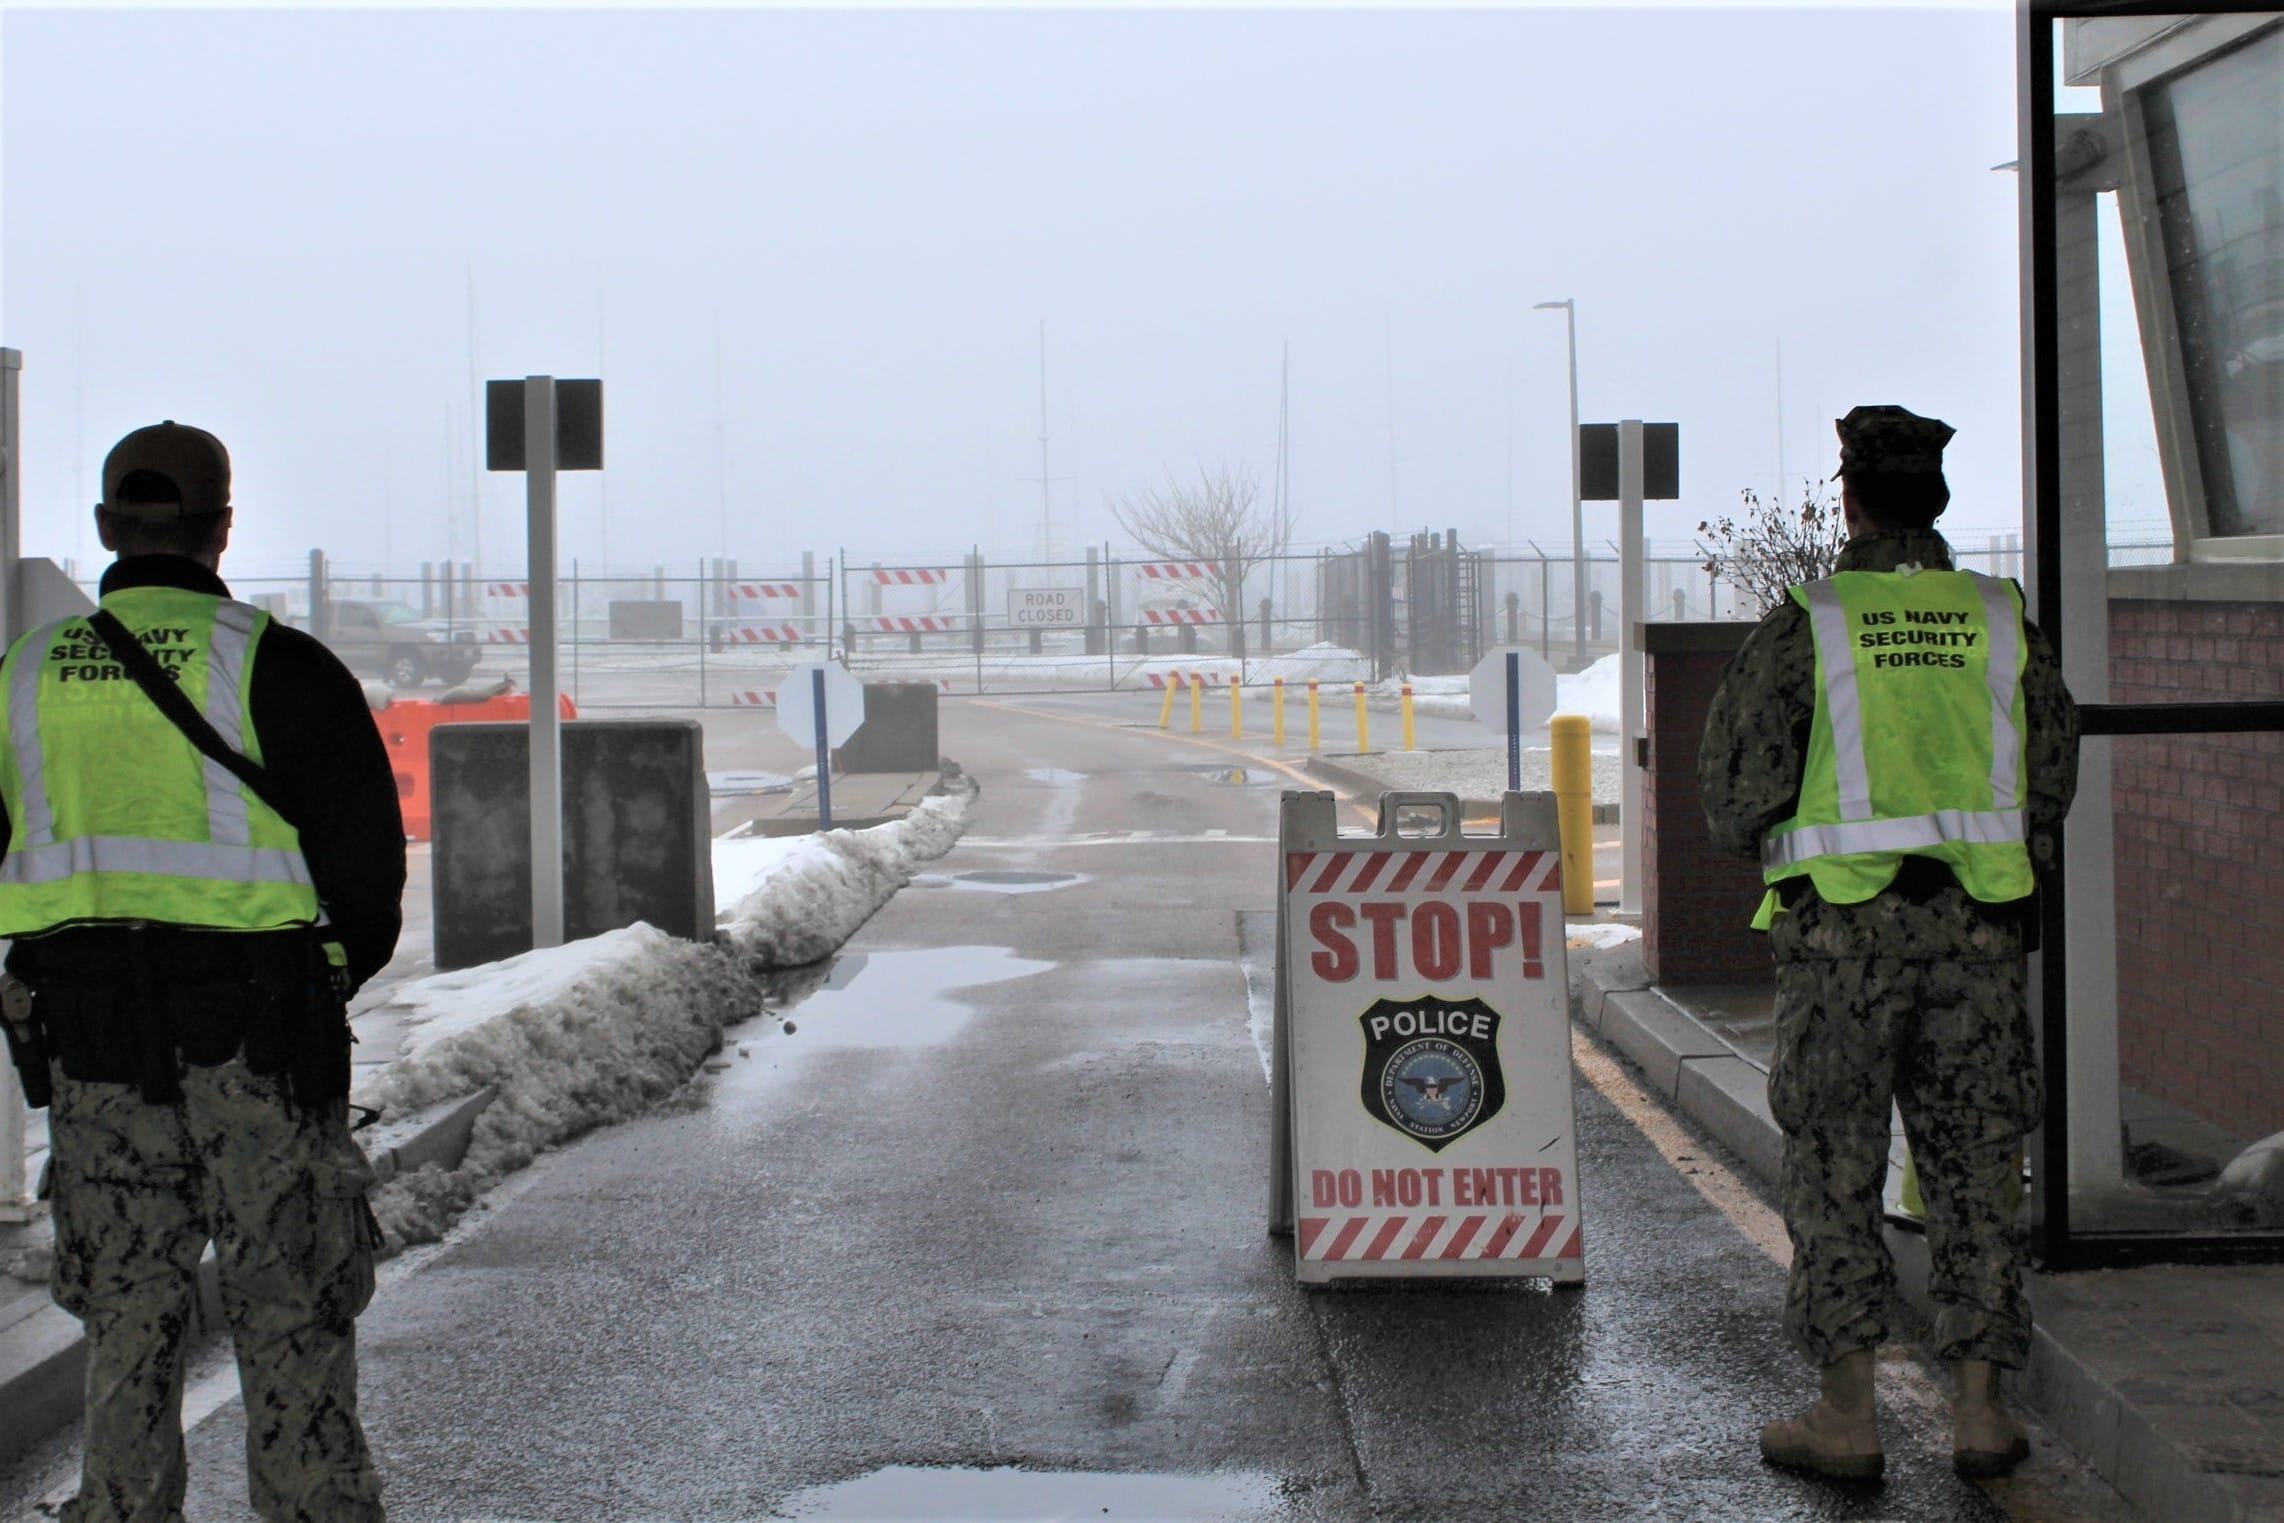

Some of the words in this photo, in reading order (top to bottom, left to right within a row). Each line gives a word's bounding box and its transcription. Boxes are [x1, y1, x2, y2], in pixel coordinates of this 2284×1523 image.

[1025, 593, 1065, 606] ROAD
[1018, 608, 1074, 622] CLOSED
[1861, 611, 1896, 625] US
[1904, 610, 1969, 624] NAVY
[136, 628, 190, 644] AVY
[1859, 630, 1977, 648] SECURITY
[1874, 652, 1966, 668] FORCES
[1310, 900, 1544, 983] STOP!
[1370, 1010, 1491, 1041] POLICE
[1385, 1042, 1431, 1087] DEPARTMENT
[1435, 1042, 1449, 1052] OF
[1452, 1049, 1479, 1085] DEFENSE
[1410, 1122, 1444, 1134] STATION
[1312, 1168, 1362, 1208] DO
[1372, 1168, 1444, 1208] NOT
[1452, 1167, 1564, 1207] ENTER
